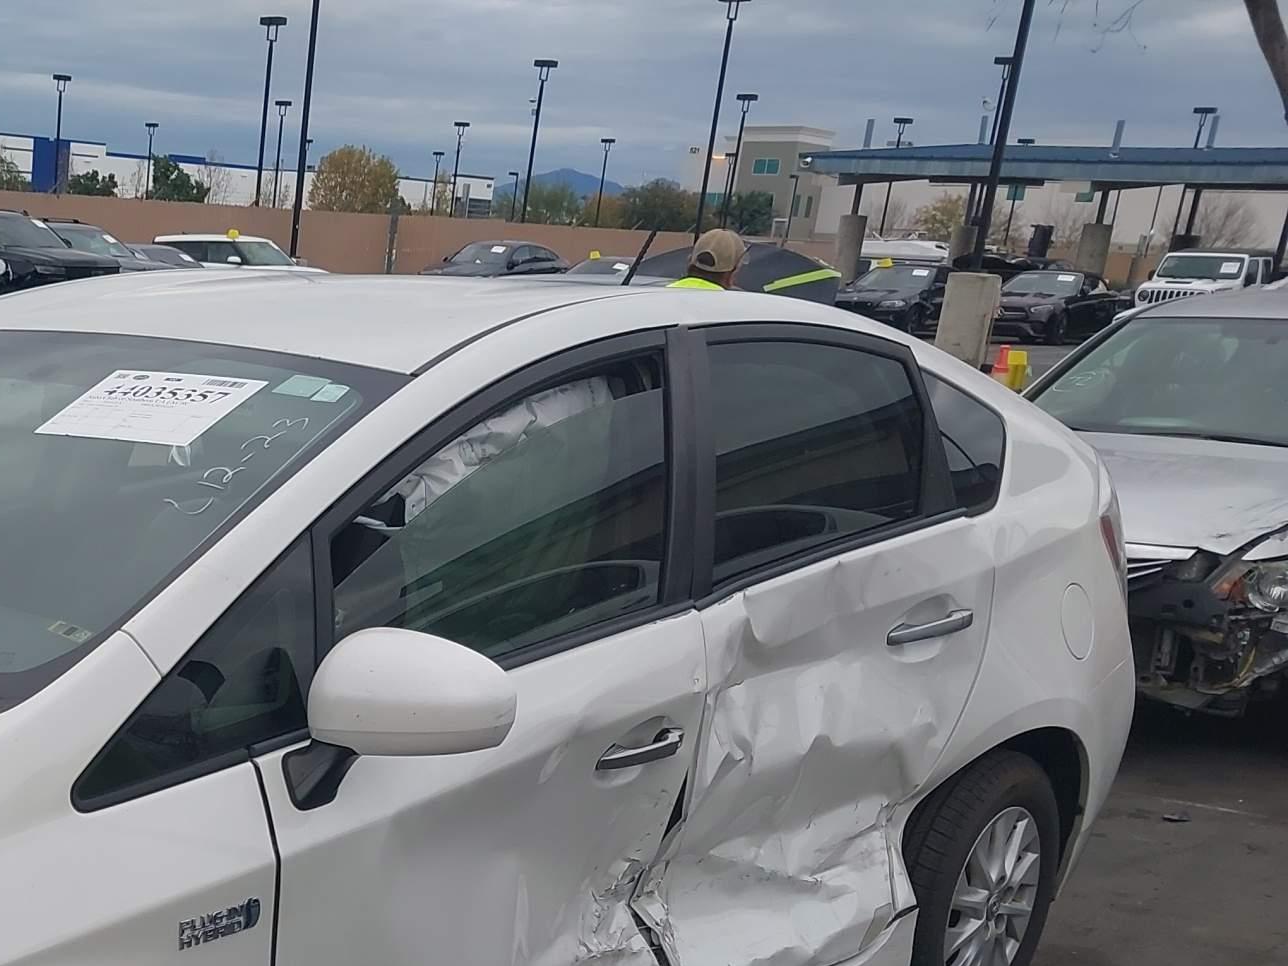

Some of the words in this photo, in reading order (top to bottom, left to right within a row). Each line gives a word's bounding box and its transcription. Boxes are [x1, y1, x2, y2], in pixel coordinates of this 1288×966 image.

[103, 383, 232, 405] 44035357
[178, 920, 242, 951] HYBRID
[179, 904, 245, 937] PLUG-IN
